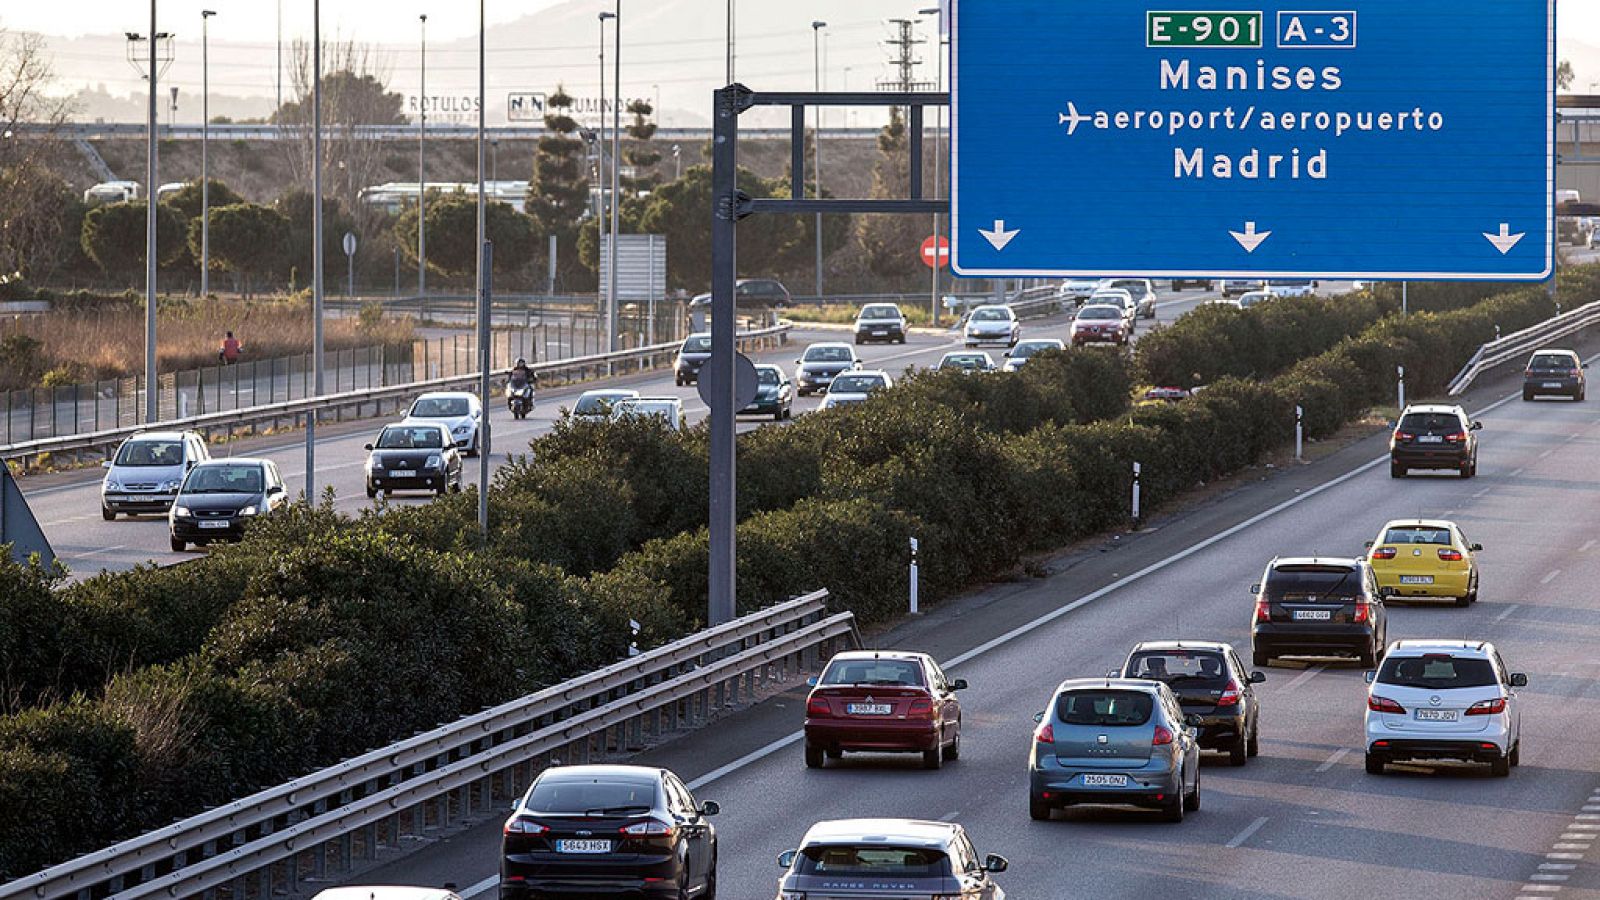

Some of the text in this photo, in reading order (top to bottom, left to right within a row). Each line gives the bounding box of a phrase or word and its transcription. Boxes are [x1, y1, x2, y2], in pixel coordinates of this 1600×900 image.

[1152, 16, 1257, 42] E-901
[1283, 16, 1350, 42] A-3
[1160, 59, 1342, 90] Manises
[1093, 106, 1443, 137] aeroport/aeropuerto
[1174, 147, 1327, 178] Madrid
